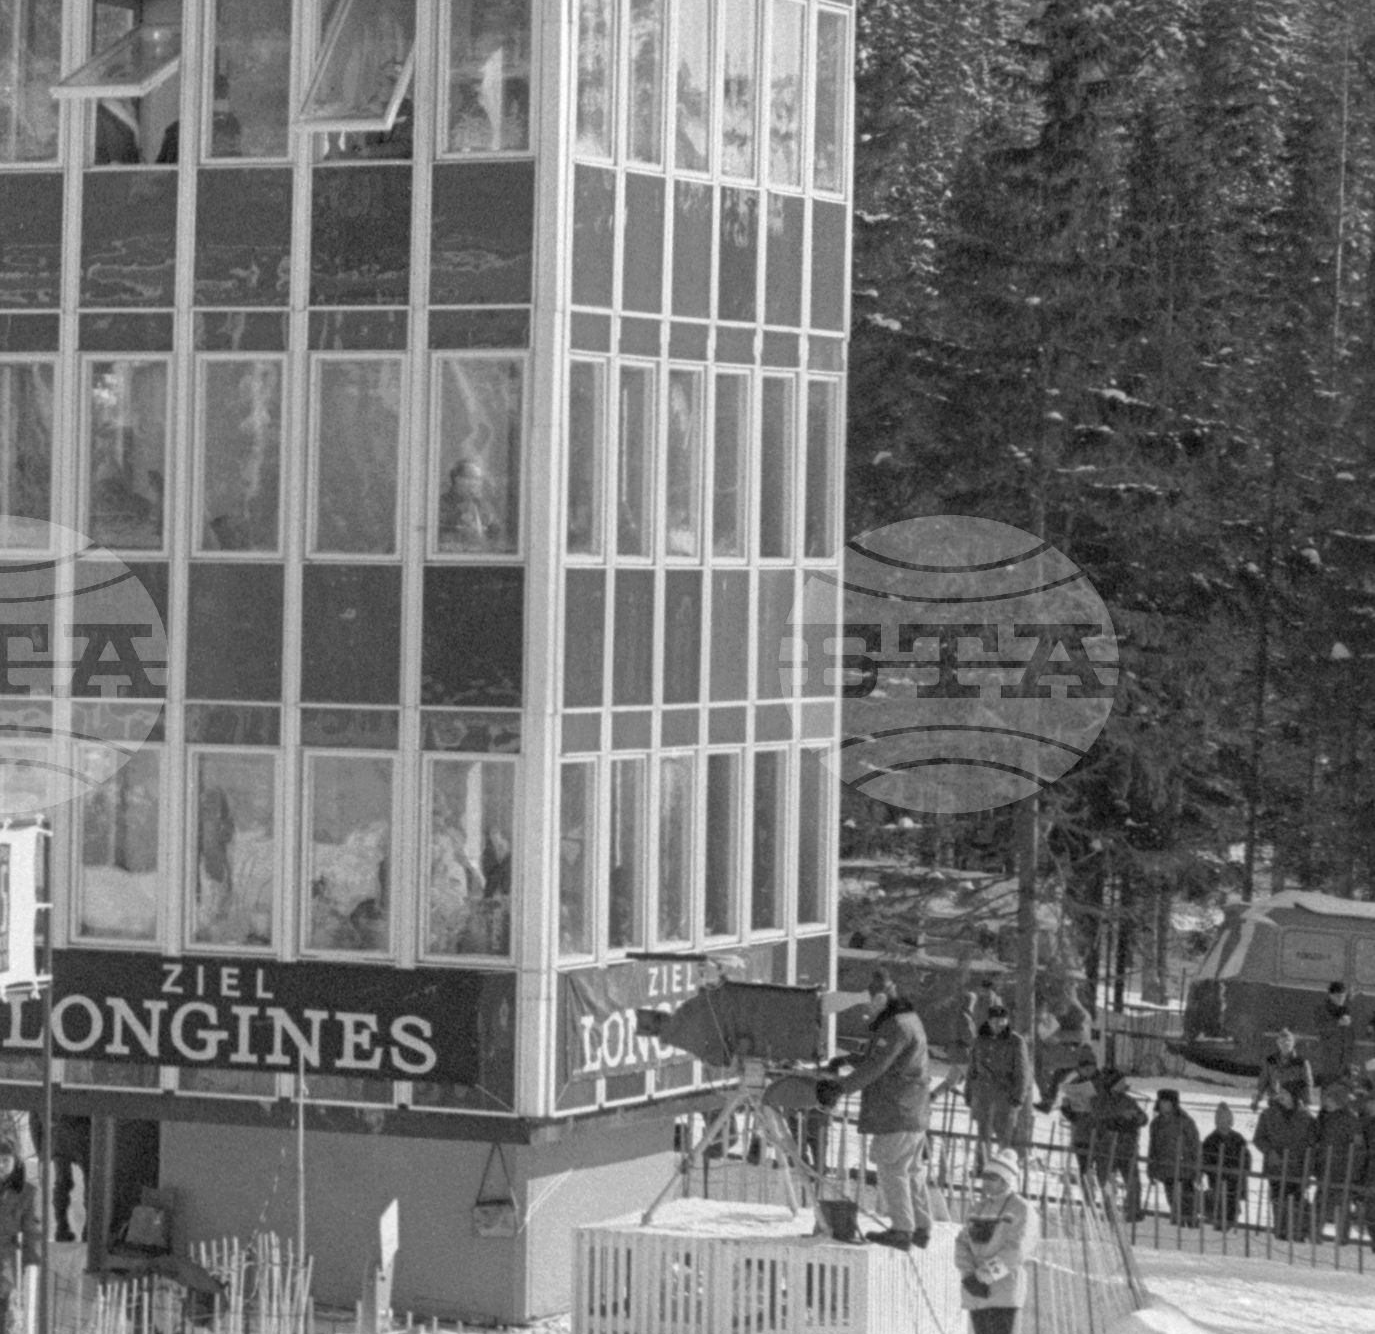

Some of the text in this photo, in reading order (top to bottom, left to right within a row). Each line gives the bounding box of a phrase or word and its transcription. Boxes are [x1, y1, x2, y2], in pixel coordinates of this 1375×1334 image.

[161, 963, 274, 999] ZIEL
[647, 962, 696, 997] ZIEL
[2, 993, 437, 1075] LONGINES
